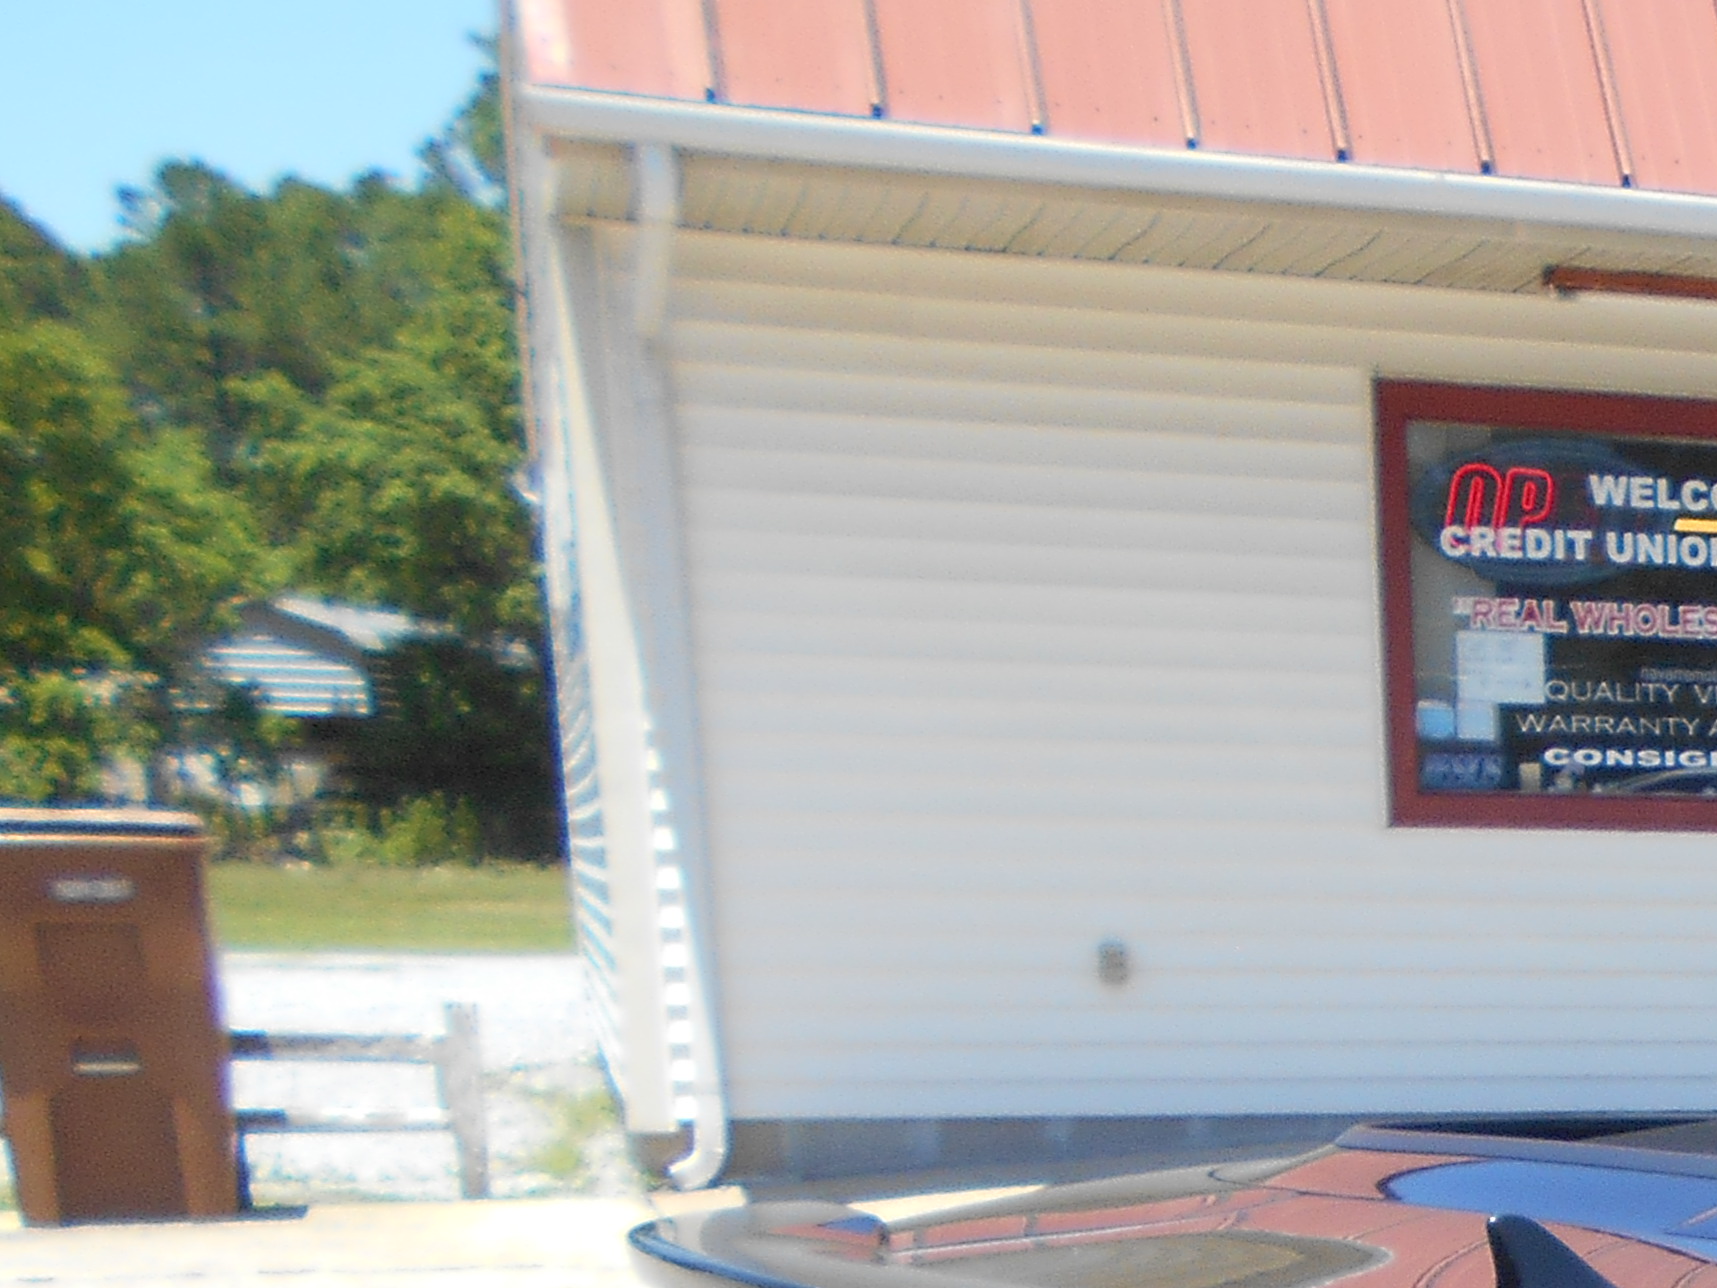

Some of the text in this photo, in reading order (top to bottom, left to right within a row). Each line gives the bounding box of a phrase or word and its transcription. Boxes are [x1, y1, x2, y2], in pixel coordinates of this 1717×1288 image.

[1439, 525, 1593, 560] CREDIT
[1545, 680, 1680, 703] QUALITY
[1516, 714, 1700, 736] WARRANTY
